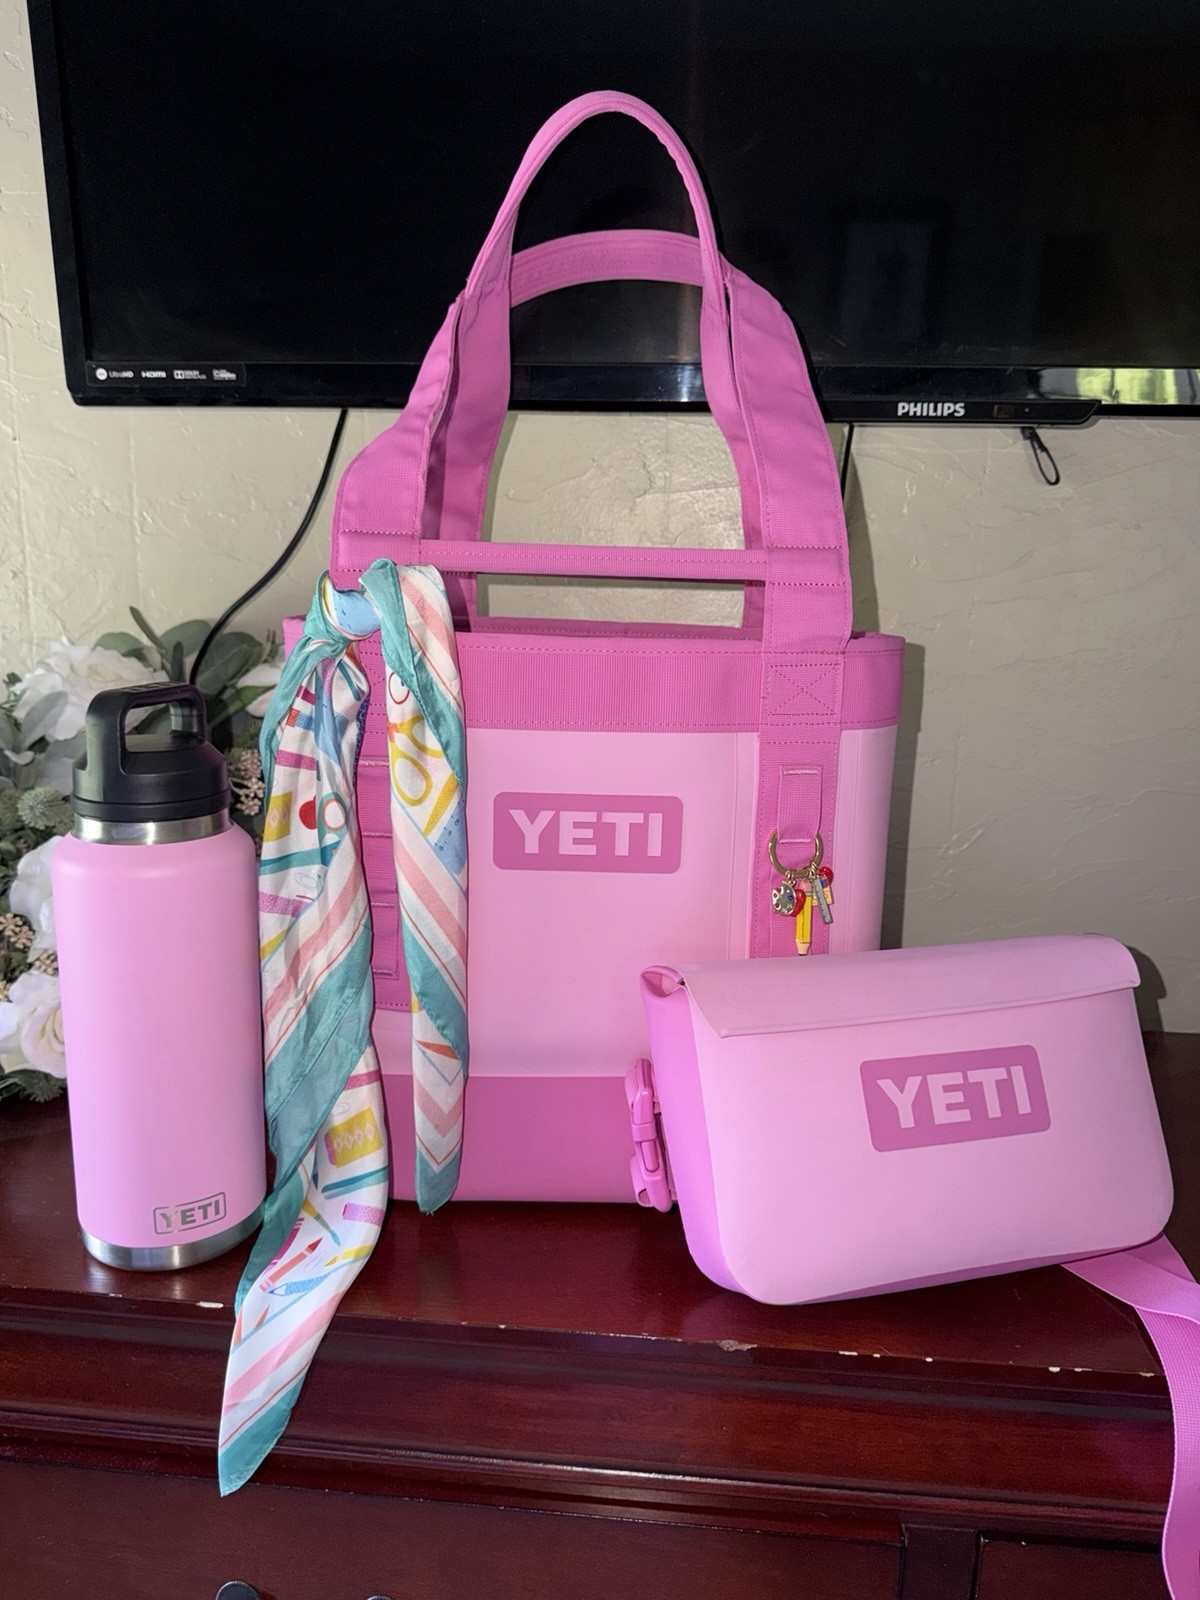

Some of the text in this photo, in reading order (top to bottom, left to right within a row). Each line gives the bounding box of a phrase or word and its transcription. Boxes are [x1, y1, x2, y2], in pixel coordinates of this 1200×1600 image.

[897, 402, 965, 417] PHILIPS
[508, 809, 663, 857] YETI
[875, 1065, 1031, 1129] YETI
[160, 1199, 220, 1228] YETI
